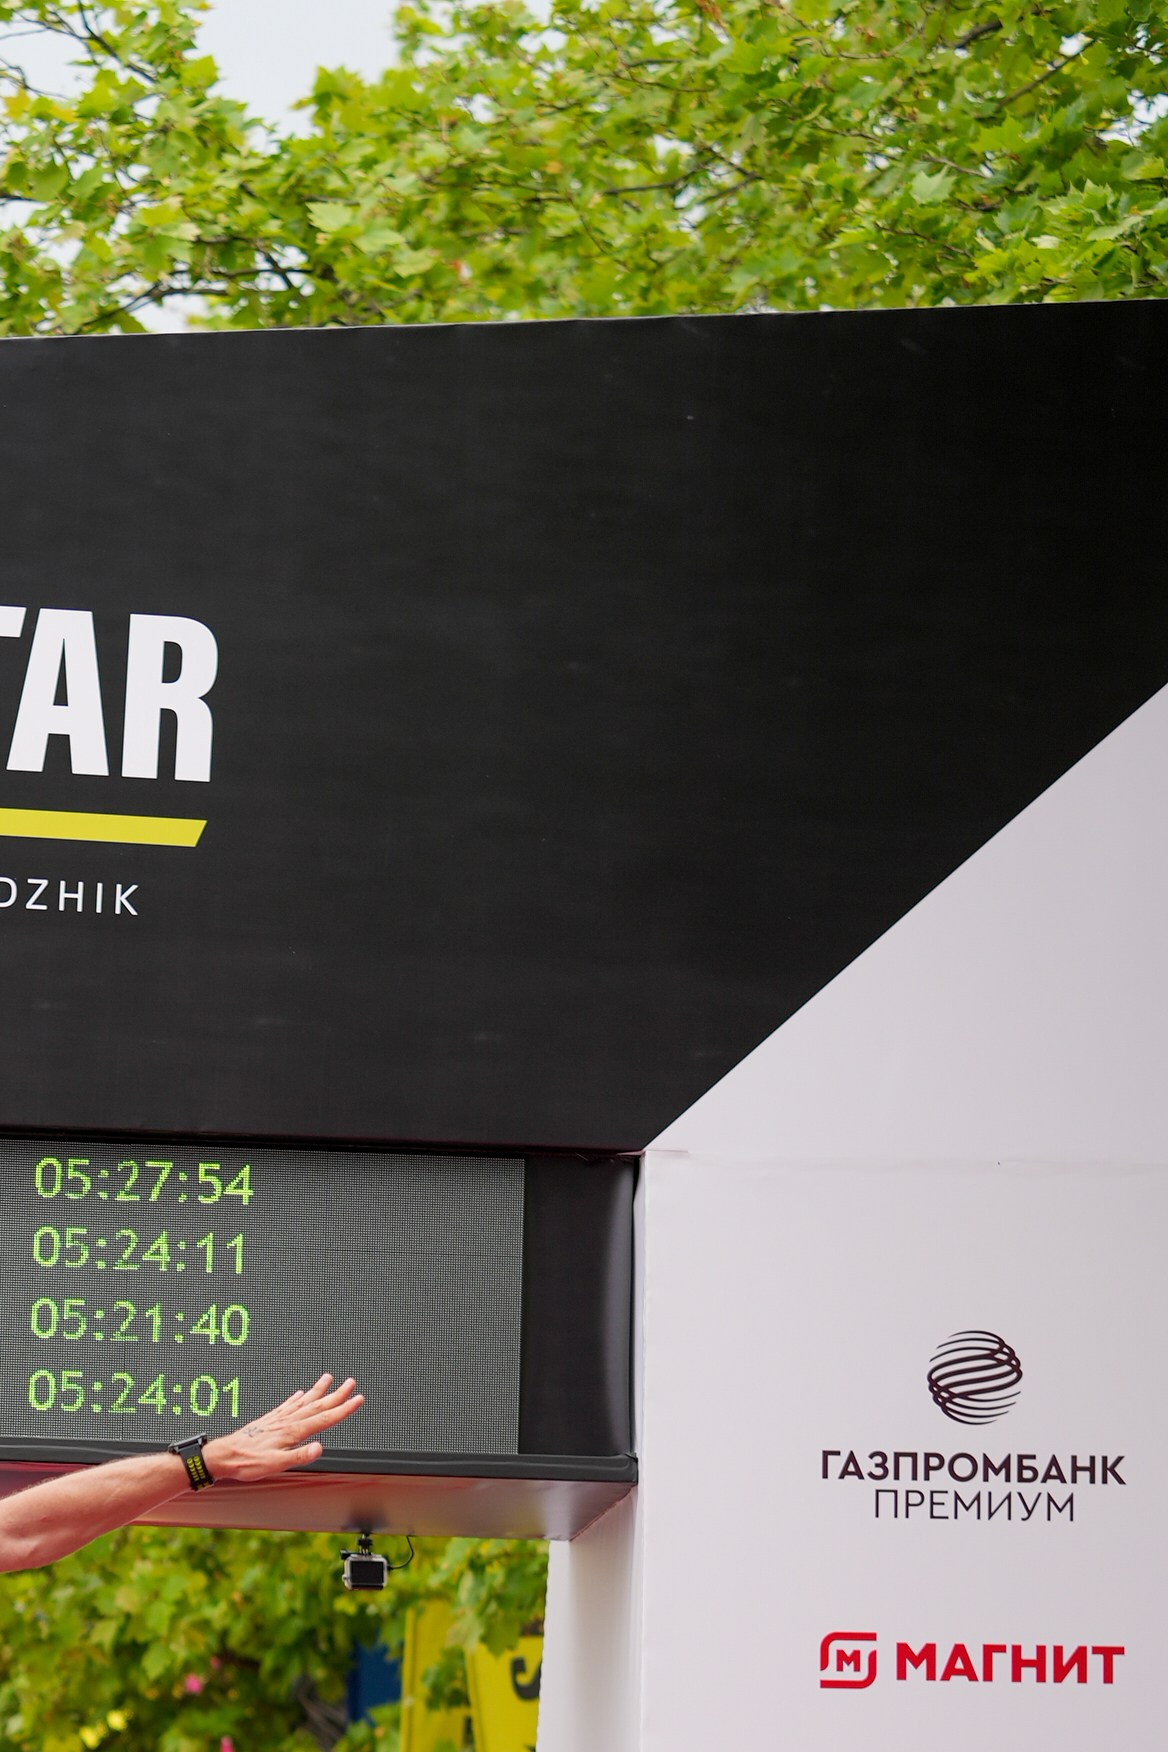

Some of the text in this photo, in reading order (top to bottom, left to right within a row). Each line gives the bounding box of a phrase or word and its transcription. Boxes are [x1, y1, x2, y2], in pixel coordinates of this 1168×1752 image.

[34, 1157, 254, 1205] 05:27:54
[33, 1226, 244, 1274] 05:24:11
[31, 1297, 250, 1346] 05:21:40
[28, 1369, 240, 1417] 05:24:01
[821, 1449, 1127, 1485] ГАЗПРОМБАНК
[874, 1488, 1076, 1522] ПРЕМИУМ
[896, 1642, 1126, 1685] МАГНИТ
